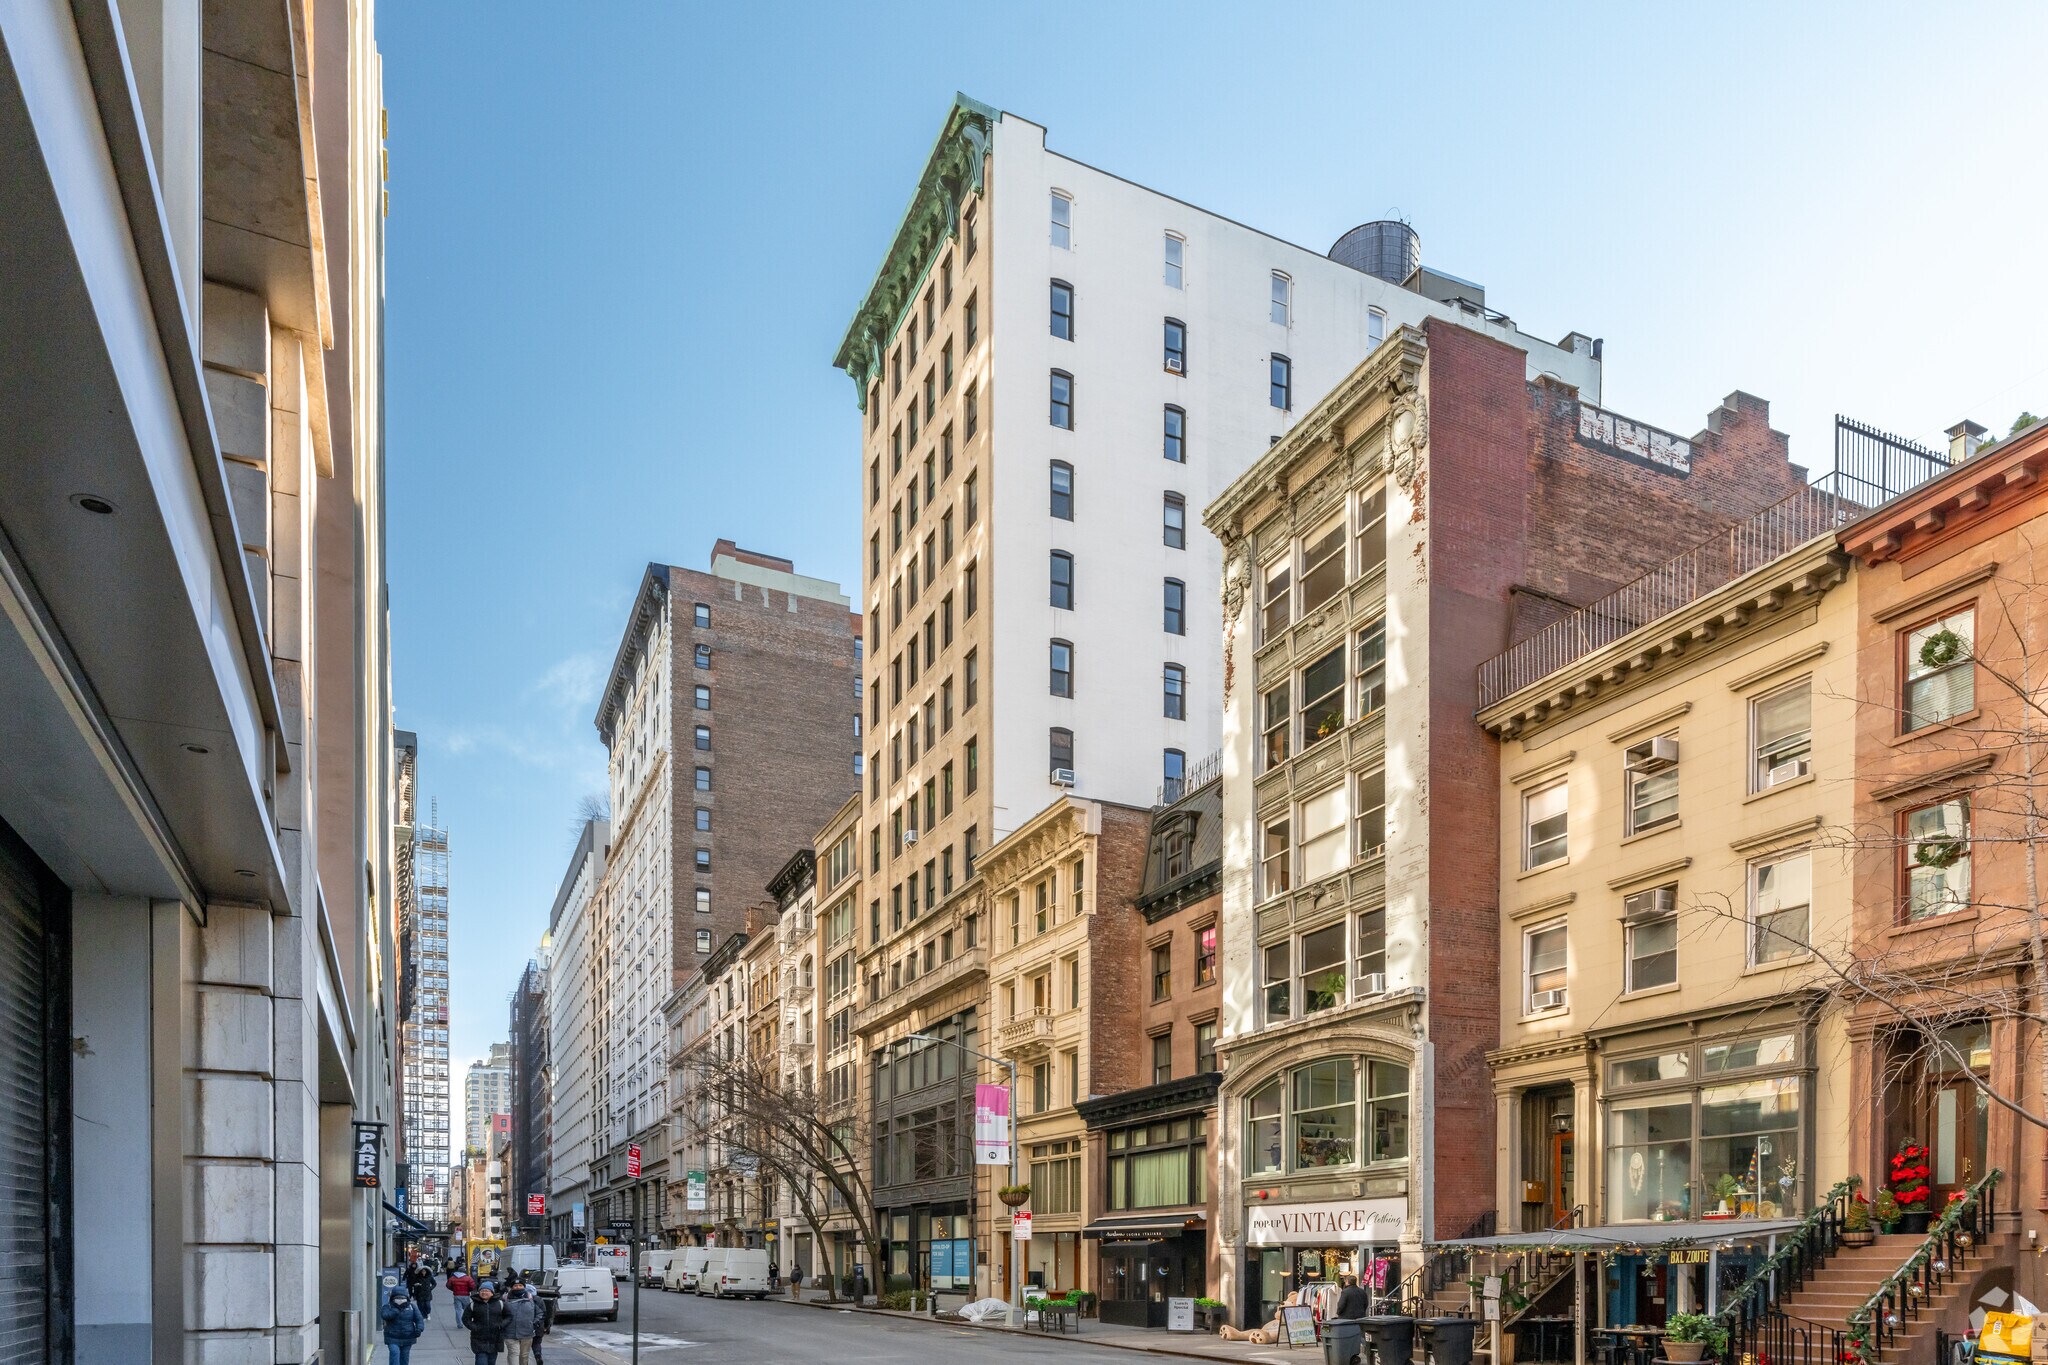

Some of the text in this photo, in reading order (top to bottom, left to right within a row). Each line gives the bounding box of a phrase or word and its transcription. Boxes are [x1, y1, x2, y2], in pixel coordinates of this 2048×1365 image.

[358, 1132, 377, 1176] PARK
[1253, 1209, 1401, 1233] POP-UP VINTAGE Clothing
[598, 1248, 628, 1257] FedEx
[1670, 1250, 1709, 1264] BXL ZOUTE
